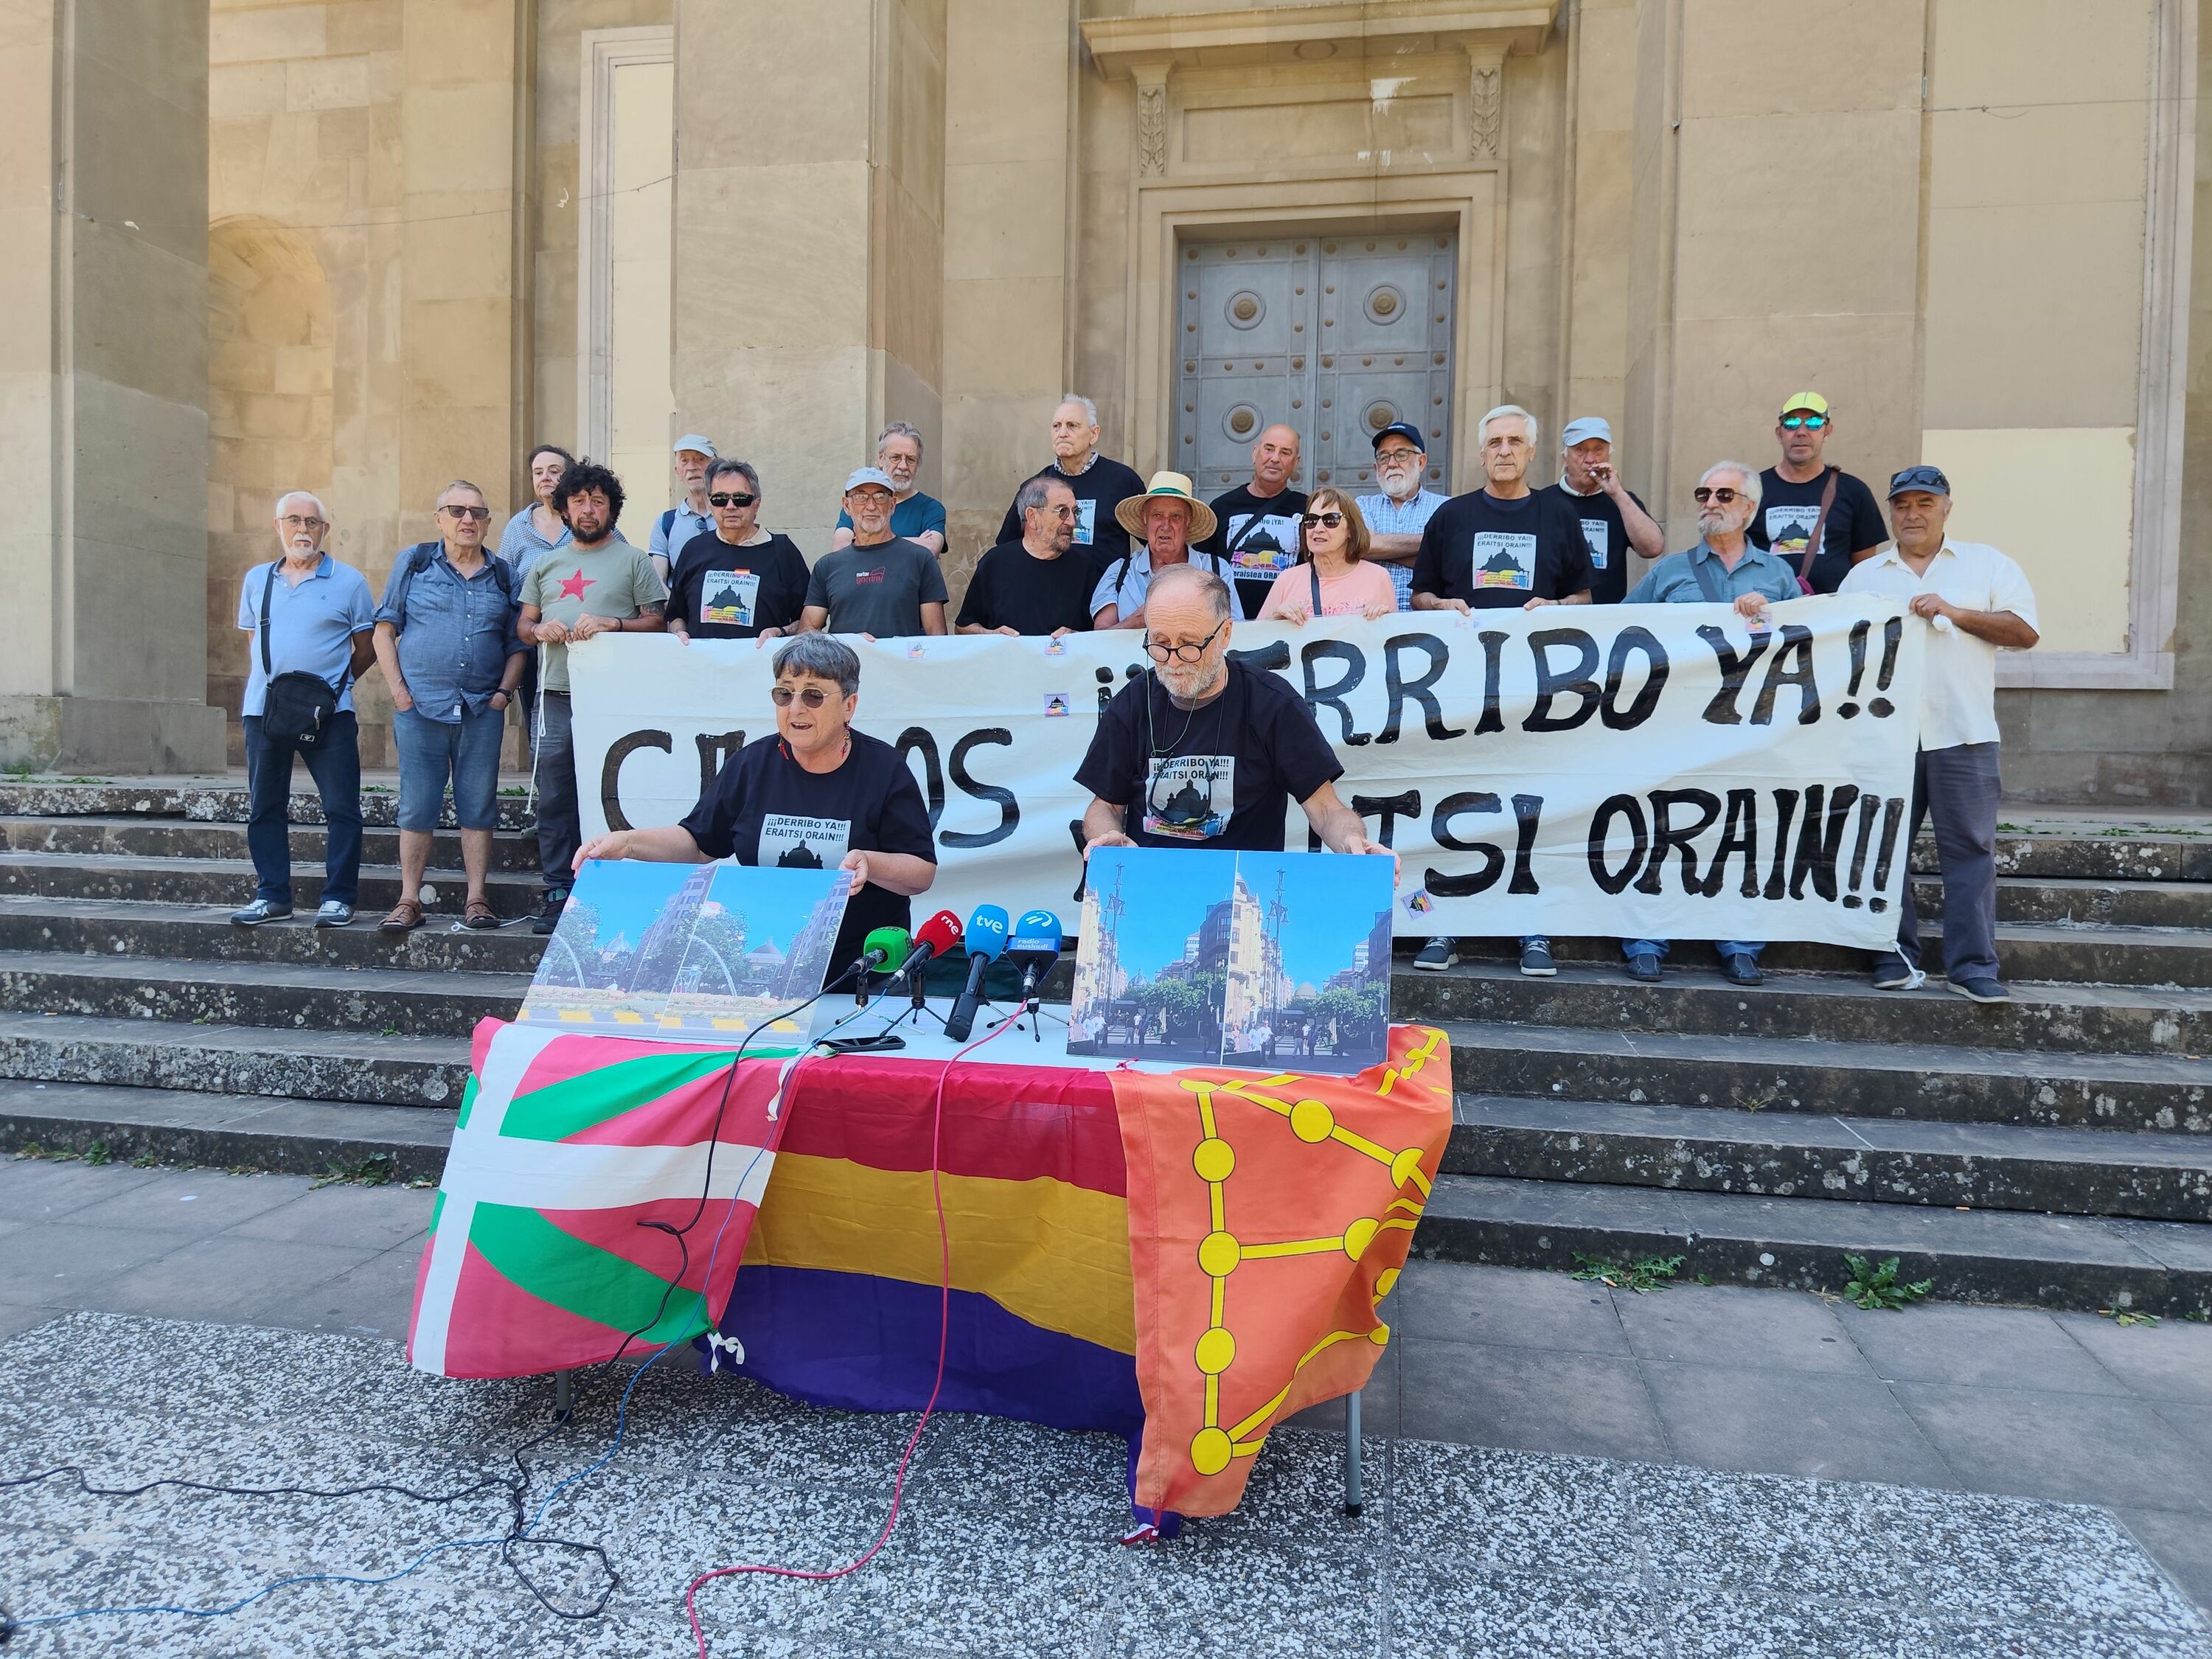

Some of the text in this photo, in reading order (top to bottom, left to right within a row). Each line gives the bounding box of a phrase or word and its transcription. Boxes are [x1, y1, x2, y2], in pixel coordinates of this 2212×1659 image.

[1208, 758, 1229, 768] YA!!!
[1152, 771, 1187, 779] ERAITSI
[768, 817, 846, 831] ¡¡¡DERRIBO YA!!!
[765, 827, 844, 841] ERAITSI ORAIN!!!
[940, 915, 959, 936] rne
[975, 914, 1004, 934] tve
